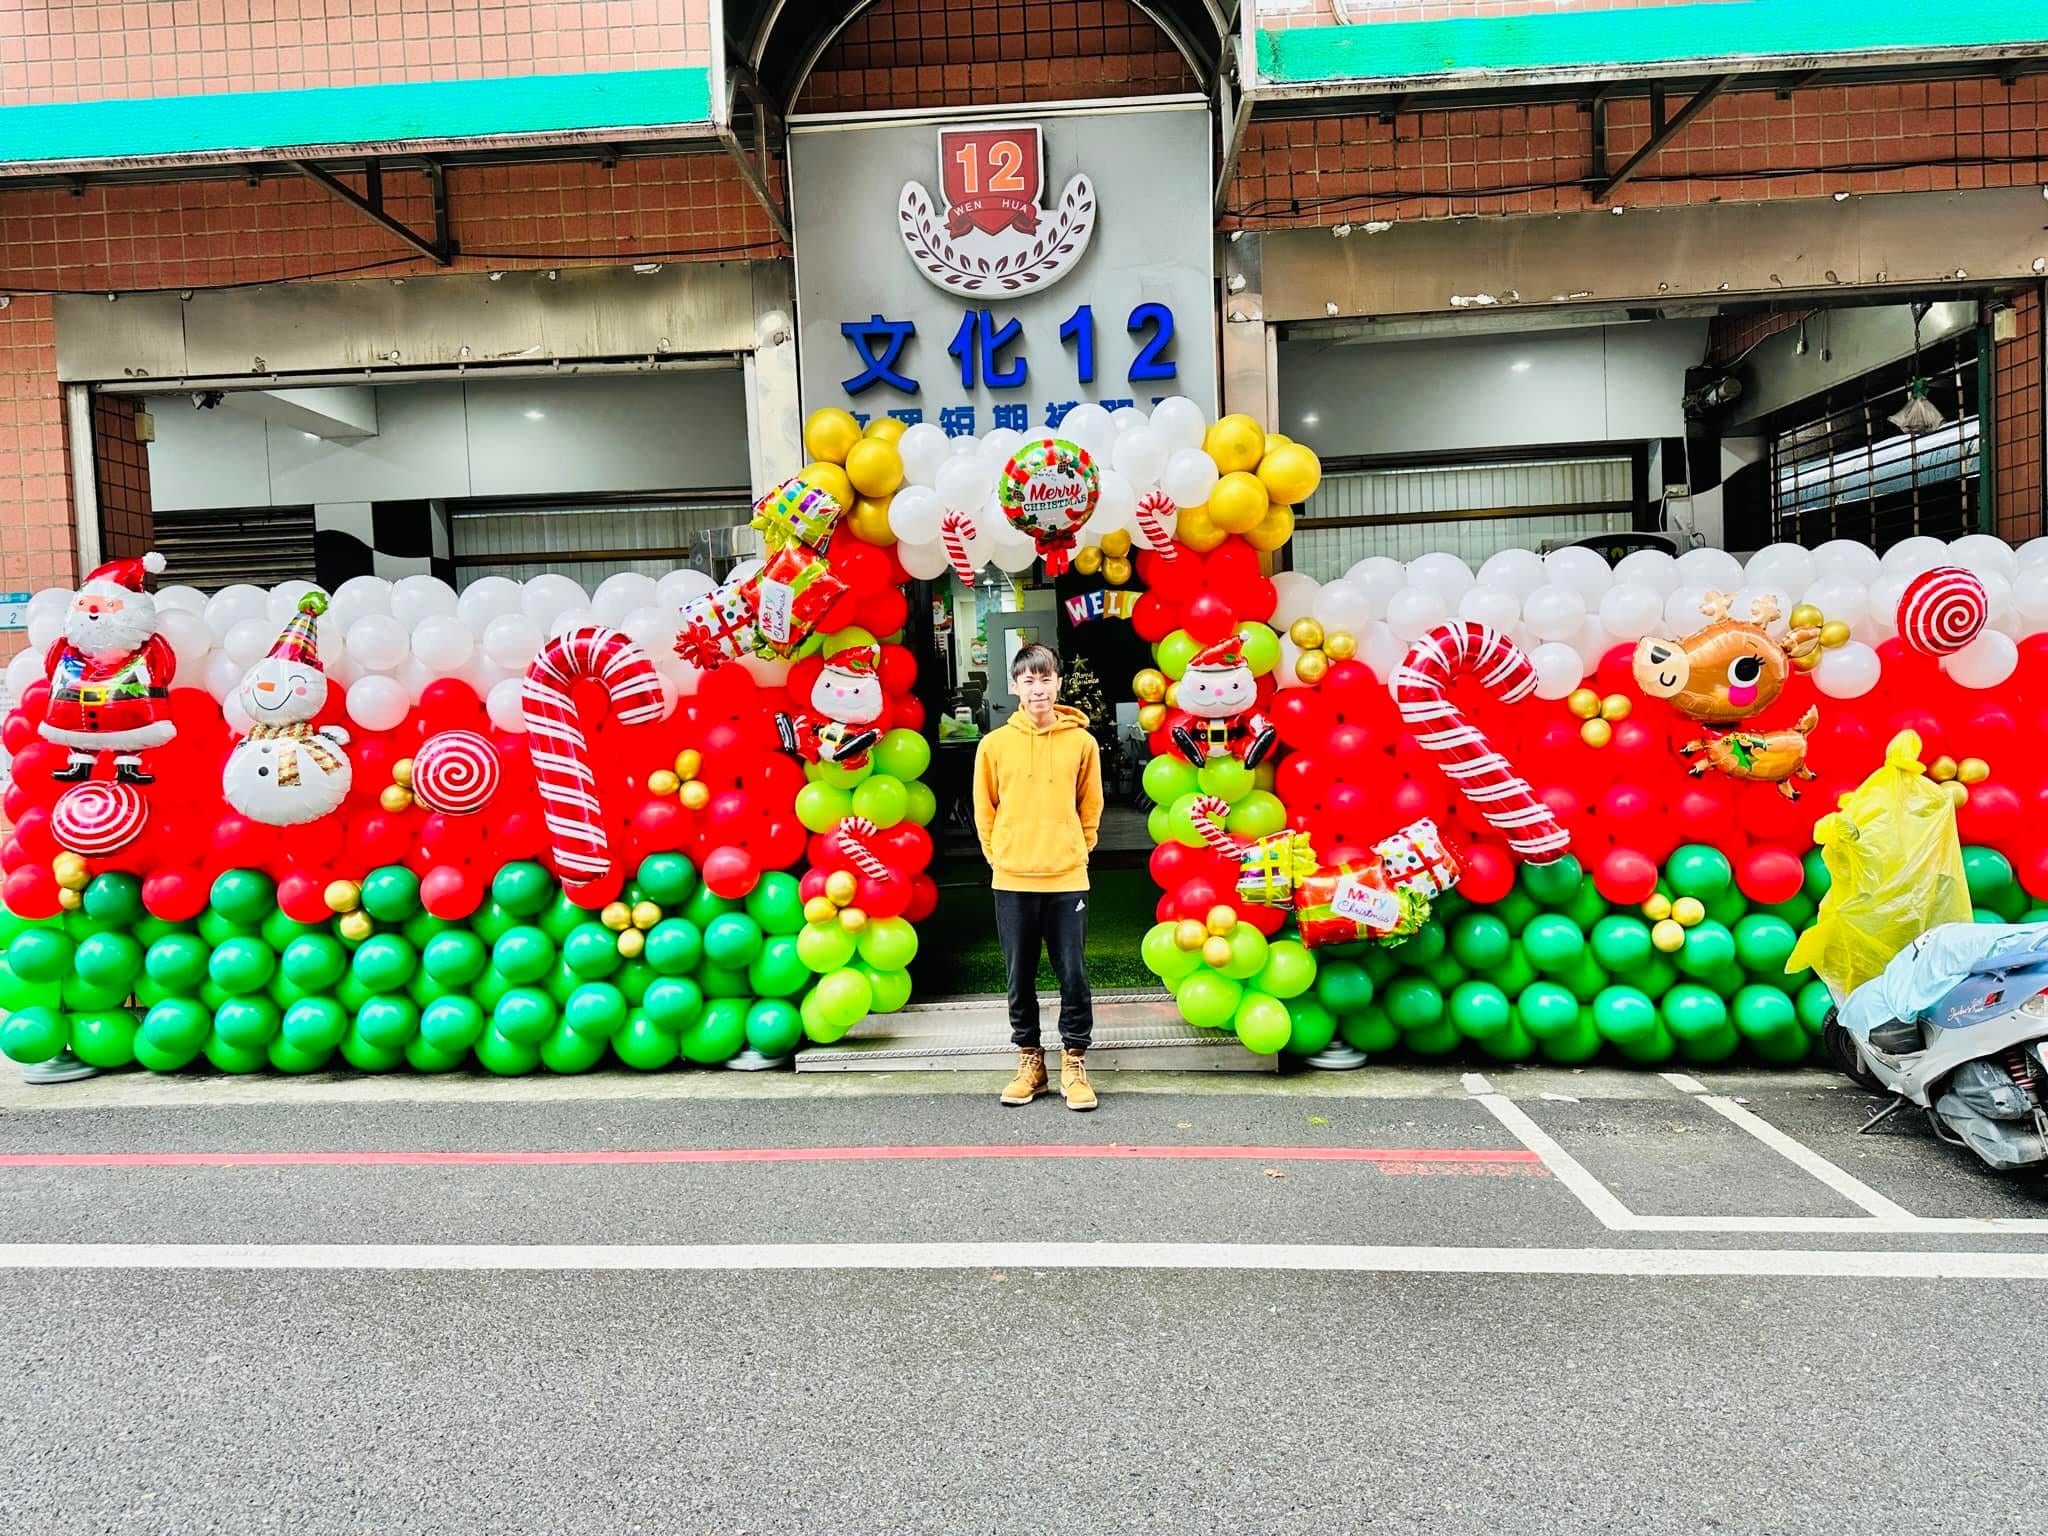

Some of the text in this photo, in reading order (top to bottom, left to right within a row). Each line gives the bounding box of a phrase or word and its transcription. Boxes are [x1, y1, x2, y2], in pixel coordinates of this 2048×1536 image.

[955, 140, 1025, 194] 12
[953, 198, 1028, 217] WEN HUA
[1030, 482, 1082, 502] Merry
